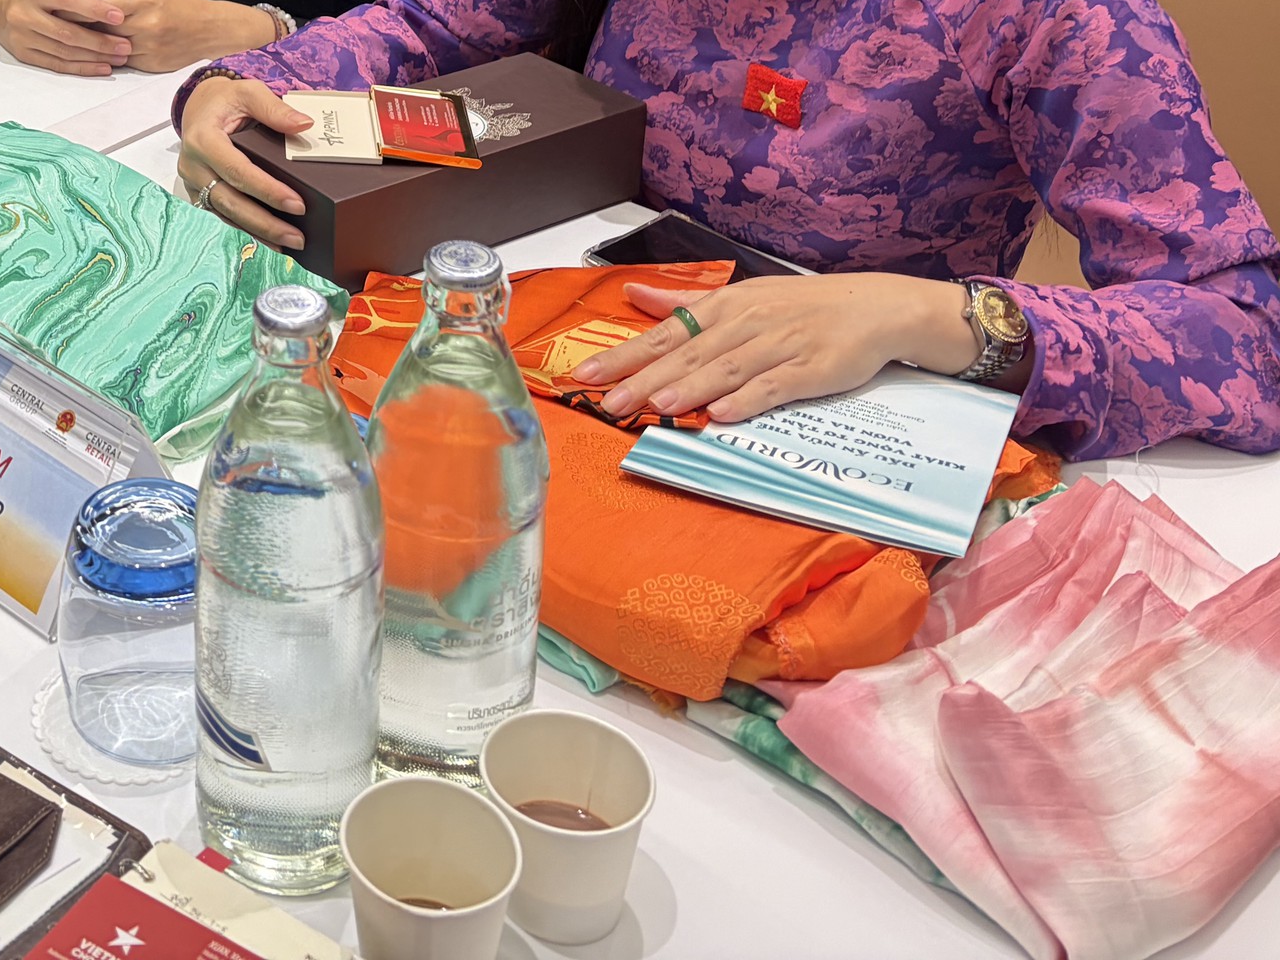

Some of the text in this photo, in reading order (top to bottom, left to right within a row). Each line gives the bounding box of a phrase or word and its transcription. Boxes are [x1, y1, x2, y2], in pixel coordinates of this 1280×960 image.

[9, 395, 38, 416] GROUP
[10, 384, 45, 411] CENTRAL
[830, 420, 856, 432] RA
[85, 444, 113, 467] RETAIL
[716, 433, 914, 492] ECOWORLD
